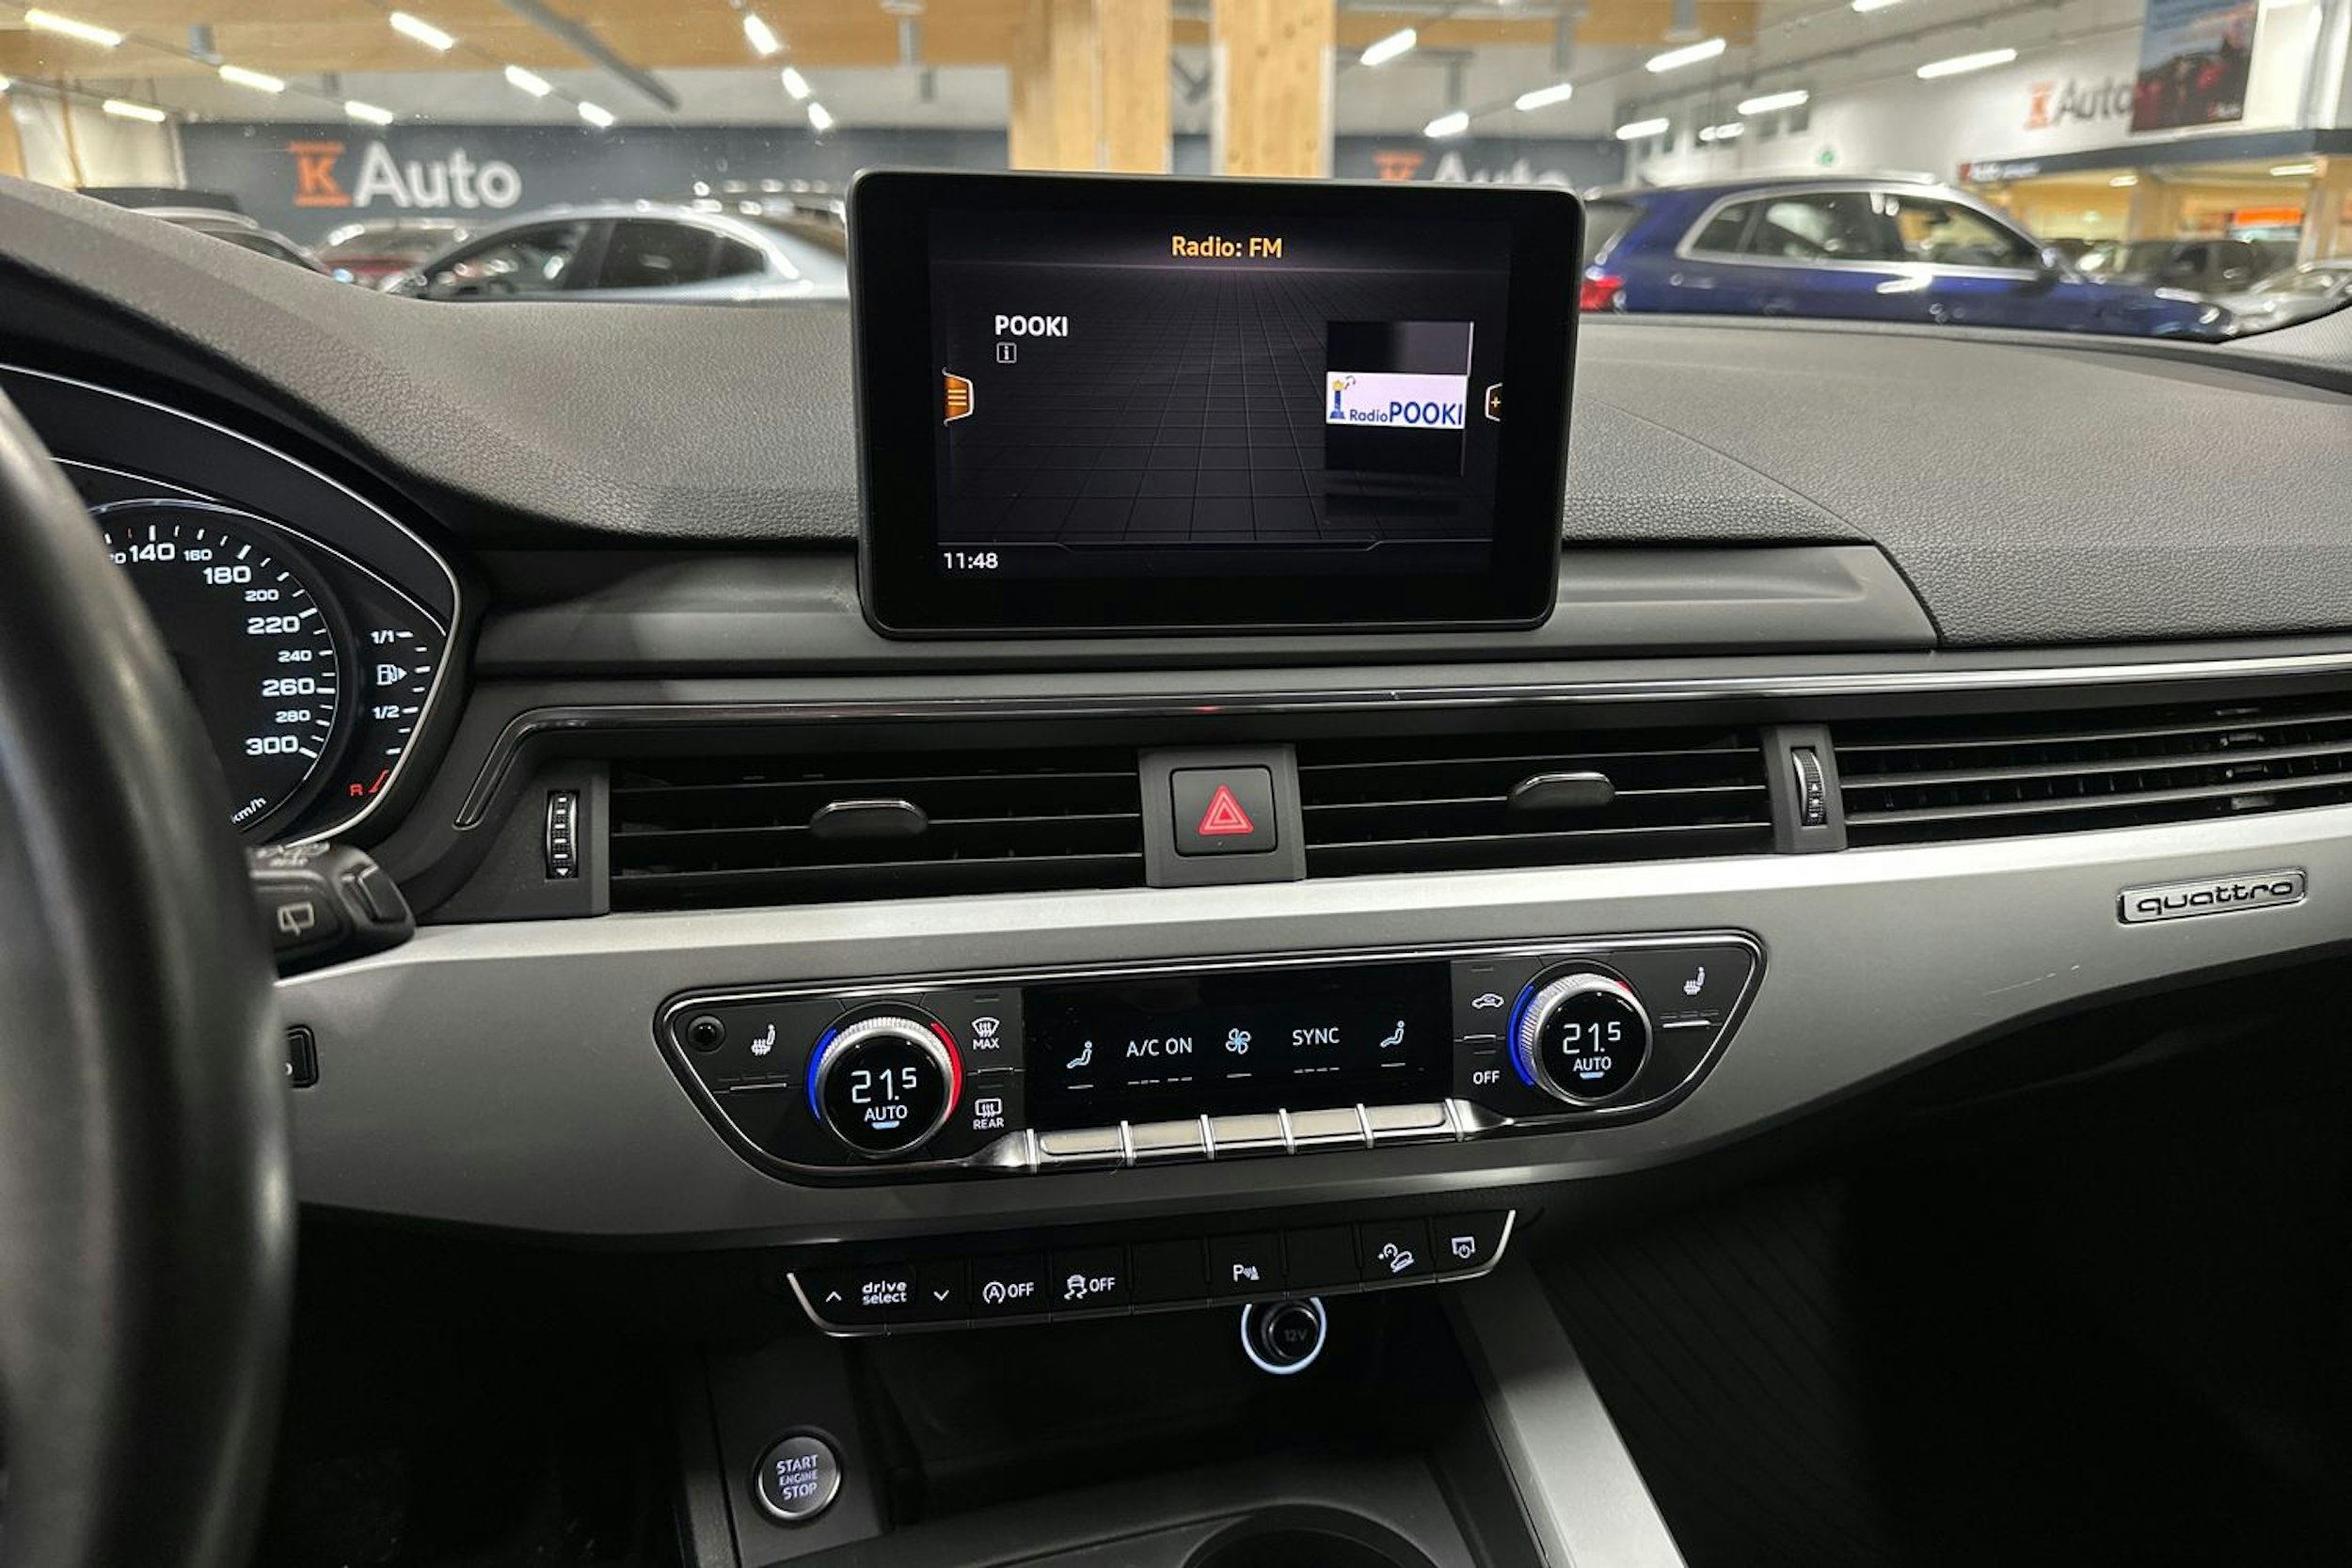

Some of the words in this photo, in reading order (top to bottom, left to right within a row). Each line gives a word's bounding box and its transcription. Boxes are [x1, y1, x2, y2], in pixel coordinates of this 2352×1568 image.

[353, 140, 522, 209] Auto
[1171, 235, 1243, 258] Radio:
[1248, 237, 1282, 259] FM
[994, 314, 1069, 337] POOKI
[129, 542, 176, 562] 140
[183, 548, 213, 562] 160
[944, 552, 999, 569] 11:48
[202, 565, 252, 585] 180
[245, 589, 279, 602] 200
[246, 615, 300, 635] 220
[371, 629, 395, 644] 1/1
[278, 649, 312, 663] 240
[262, 677, 315, 697] 260
[275, 709, 311, 723] 280
[373, 705, 400, 720] 1/2
[246, 735, 299, 755] 300
[349, 784, 363, 797] R
[2137, 880, 2293, 915] quattro
[973, 1037, 1000, 1051] MAX
[1292, 1026, 1340, 1046] SYNC
[1562, 1021, 1621, 1054] 21.5
[1126, 1039, 1159, 1058] A/C
[1165, 1037, 1193, 1055] ON
[1573, 1055, 1612, 1072] AUTO
[850, 1067, 917, 1103] 21.5
[1472, 1069, 1501, 1085] OFF
[864, 1104, 908, 1122] AUTO
[973, 1116, 1005, 1130] REAR
[862, 1280, 907, 1294] drive
[1007, 1281, 1035, 1298] OFF
[1089, 1276, 1116, 1293] OFF
[862, 1292, 907, 1306] select
[1284, 1329, 1309, 1342] 12V
[776, 1454, 818, 1475] START
[779, 1469, 818, 1486] ENGINE
[783, 1481, 818, 1500] STOP
